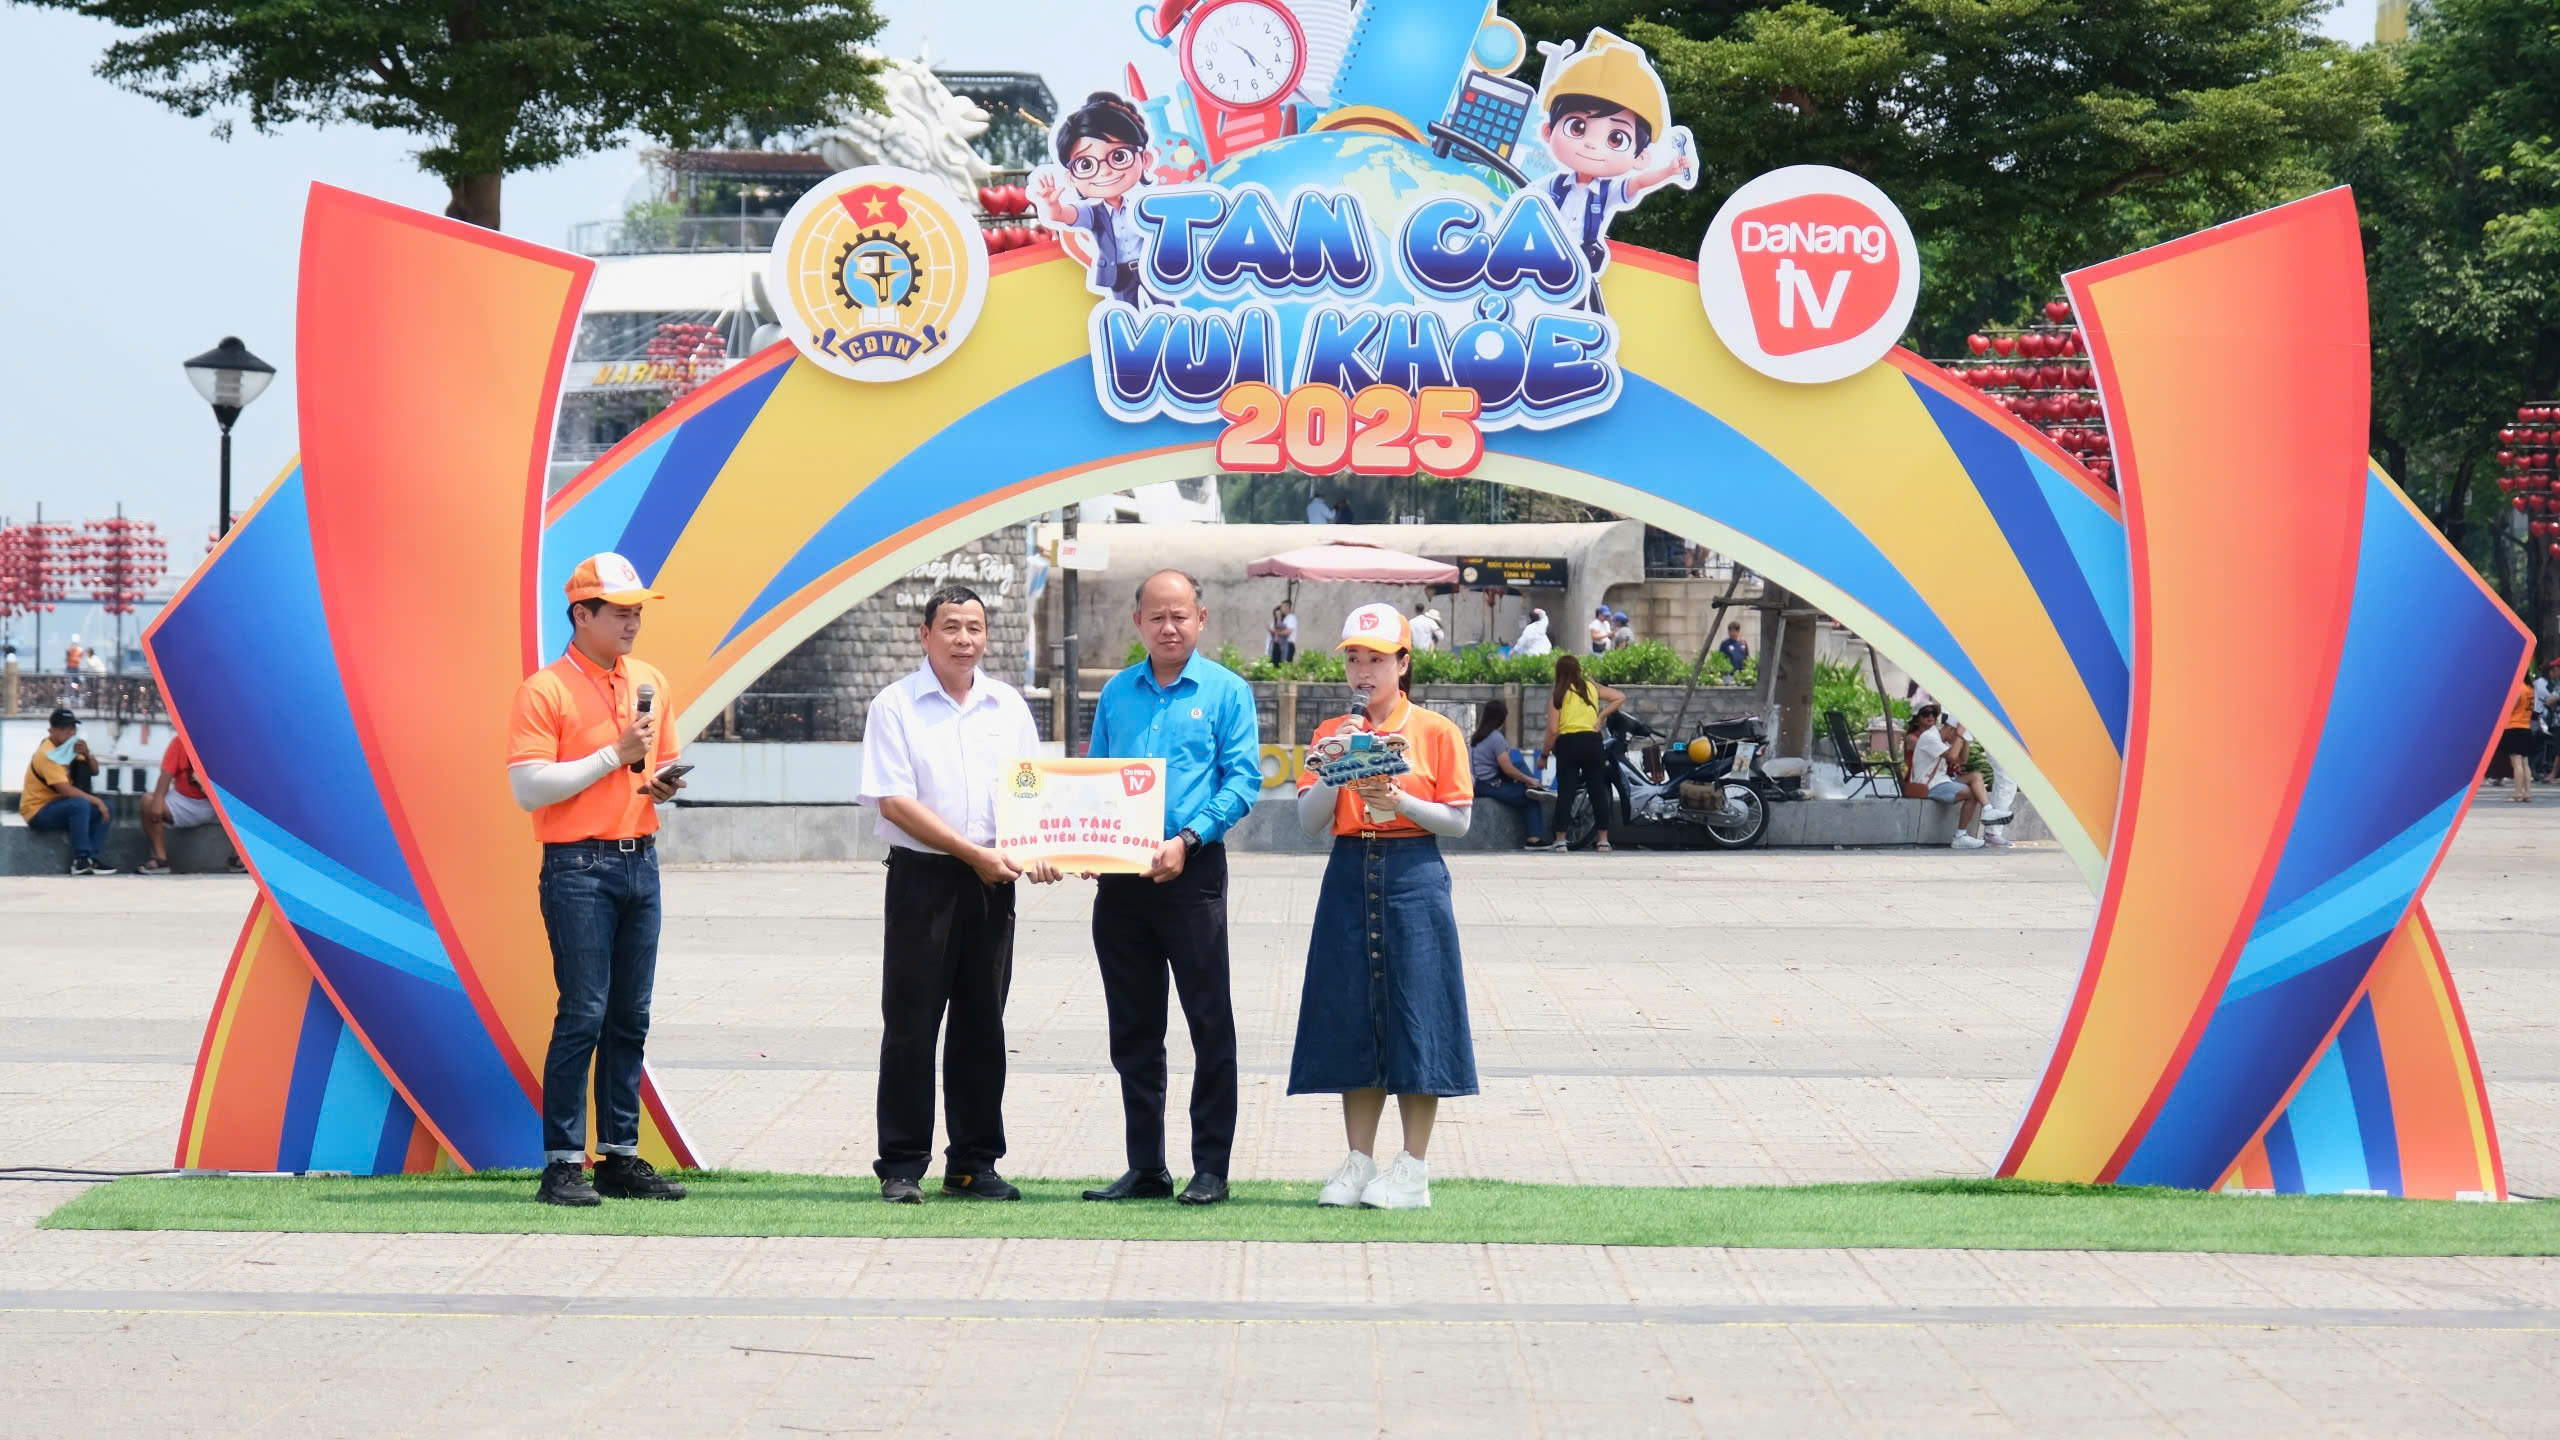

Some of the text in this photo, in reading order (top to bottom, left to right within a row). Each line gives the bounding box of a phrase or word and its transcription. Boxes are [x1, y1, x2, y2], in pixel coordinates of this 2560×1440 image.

[1263, 22, 1272, 35] 2
[1273, 36, 1282, 48] 3
[1274, 53, 1282, 63] 4
[1205, 59, 1214, 71] 9
[1217, 72, 1226, 84] 8
[1266, 68, 1275, 80] 5
[1233, 79, 1240, 91] 7
[1250, 79, 1259, 90] 6
[1138, 190, 1584, 298] TAN CA
[1742, 221, 1887, 265] DaNang
[1102, 294, 1616, 412] VUI KHỎE
[1216, 381, 1482, 476] 2025
[1039, 816, 1072, 831] QUÀ
[1001, 831, 1160, 850] ĐOÀN VIÊN CÔNG ĐOÀN
